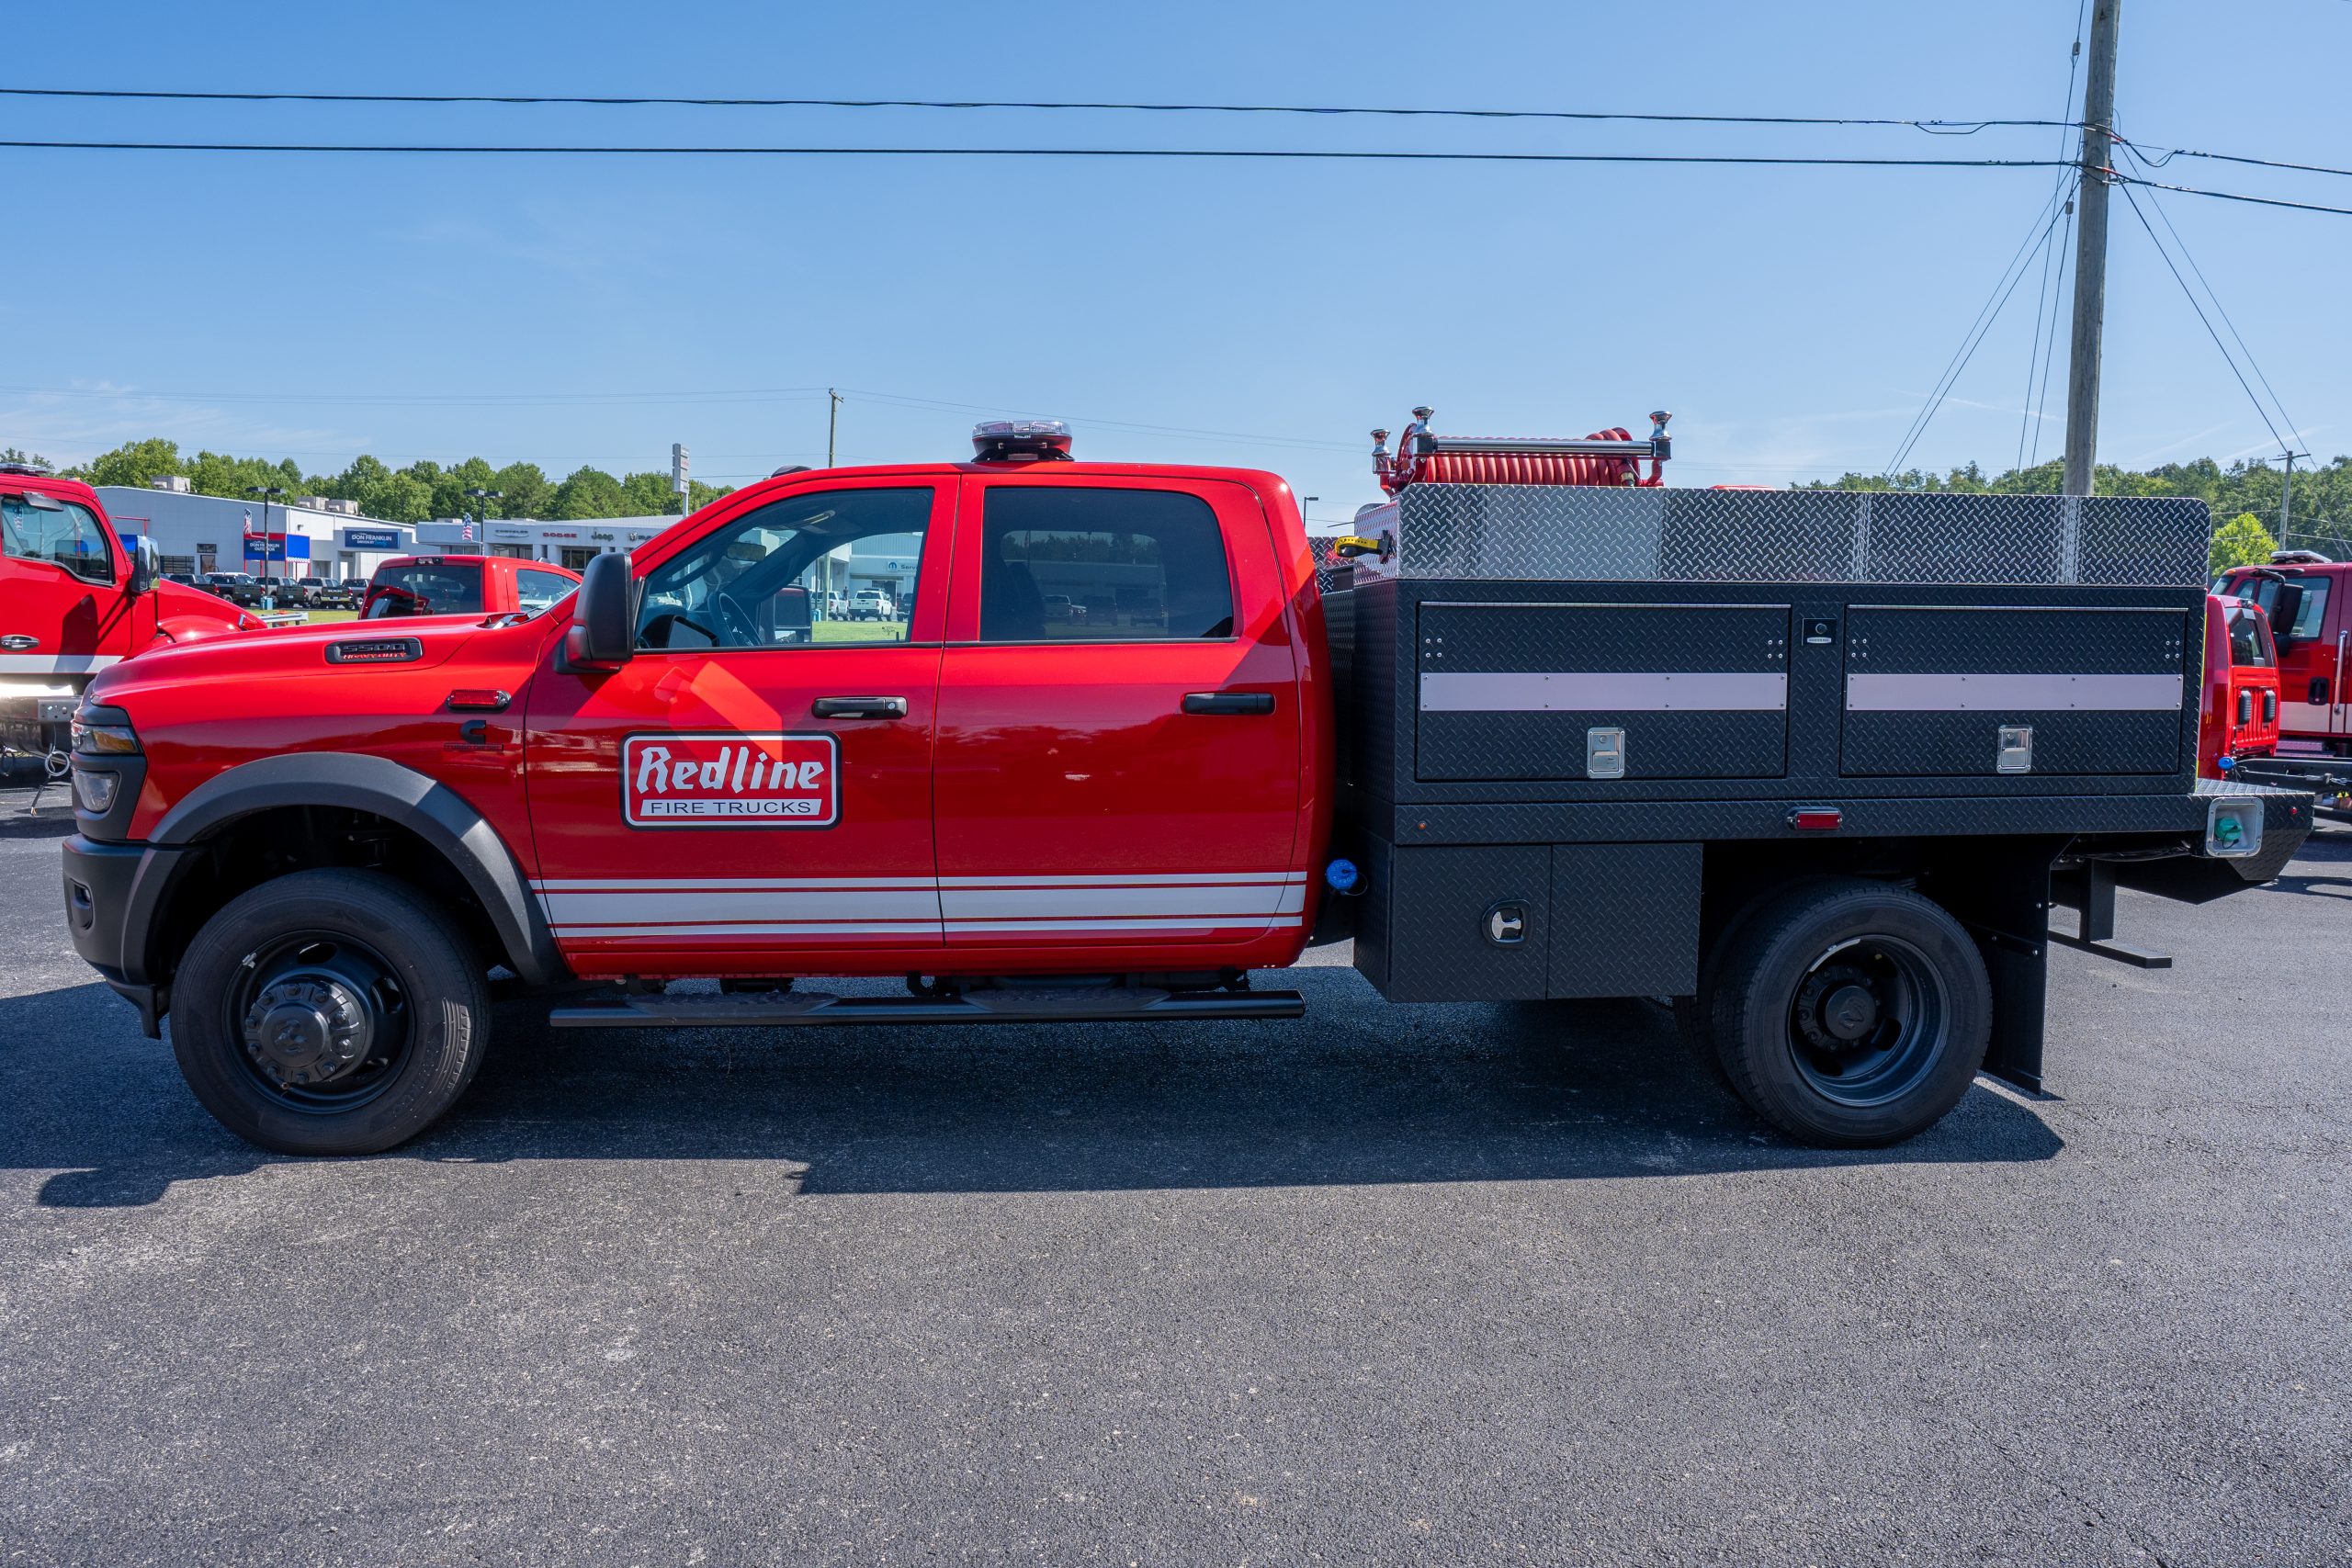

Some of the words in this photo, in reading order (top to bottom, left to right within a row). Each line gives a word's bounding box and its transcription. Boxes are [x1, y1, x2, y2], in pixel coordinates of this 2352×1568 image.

[591, 532, 614, 541] Jeep
[636, 746, 825, 795] Redline
[650, 801, 705, 814] FIRE
[712, 801, 811, 814] TRUCKS
